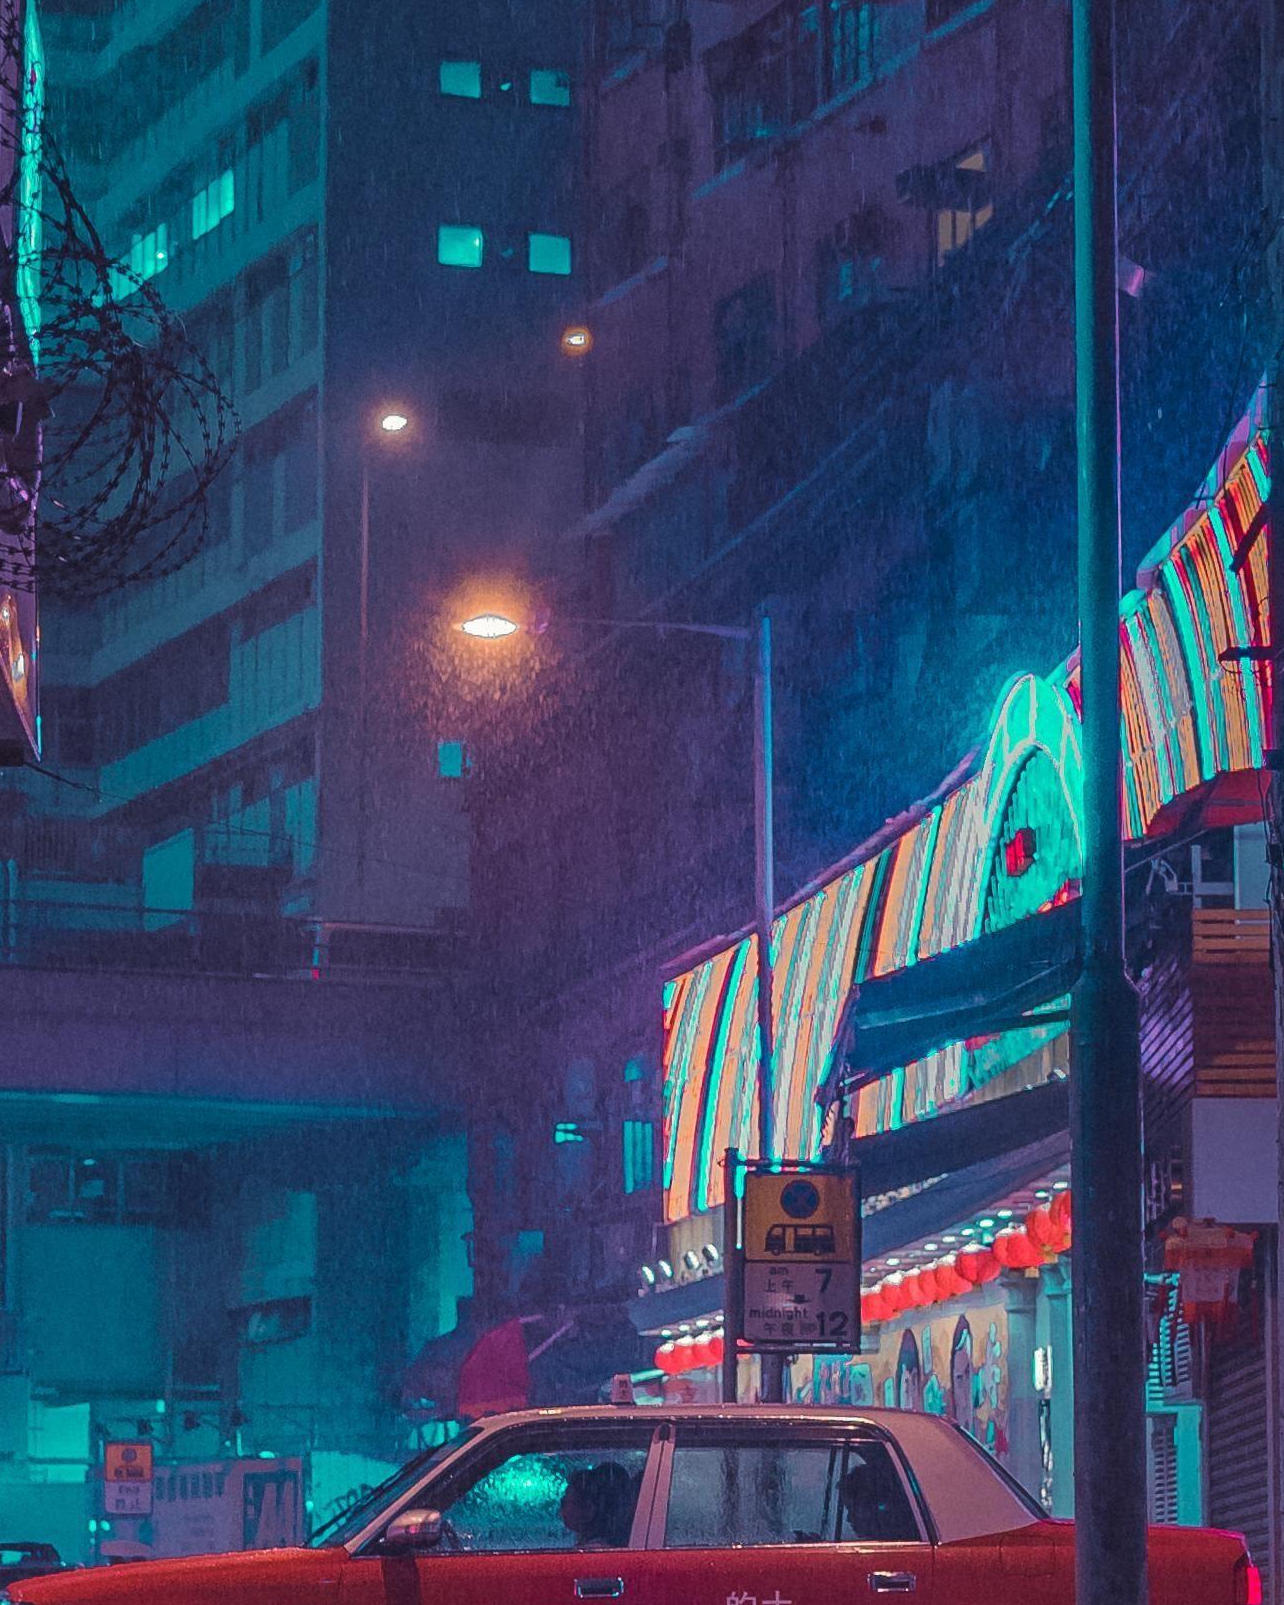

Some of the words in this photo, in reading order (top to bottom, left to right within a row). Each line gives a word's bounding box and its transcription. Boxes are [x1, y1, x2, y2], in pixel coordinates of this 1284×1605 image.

[769, 1266, 789, 1275] am
[763, 1278, 794, 1292] 上午
[815, 1268, 833, 1293] 7
[749, 1305, 808, 1321] midnight
[816, 1311, 849, 1336] 12
